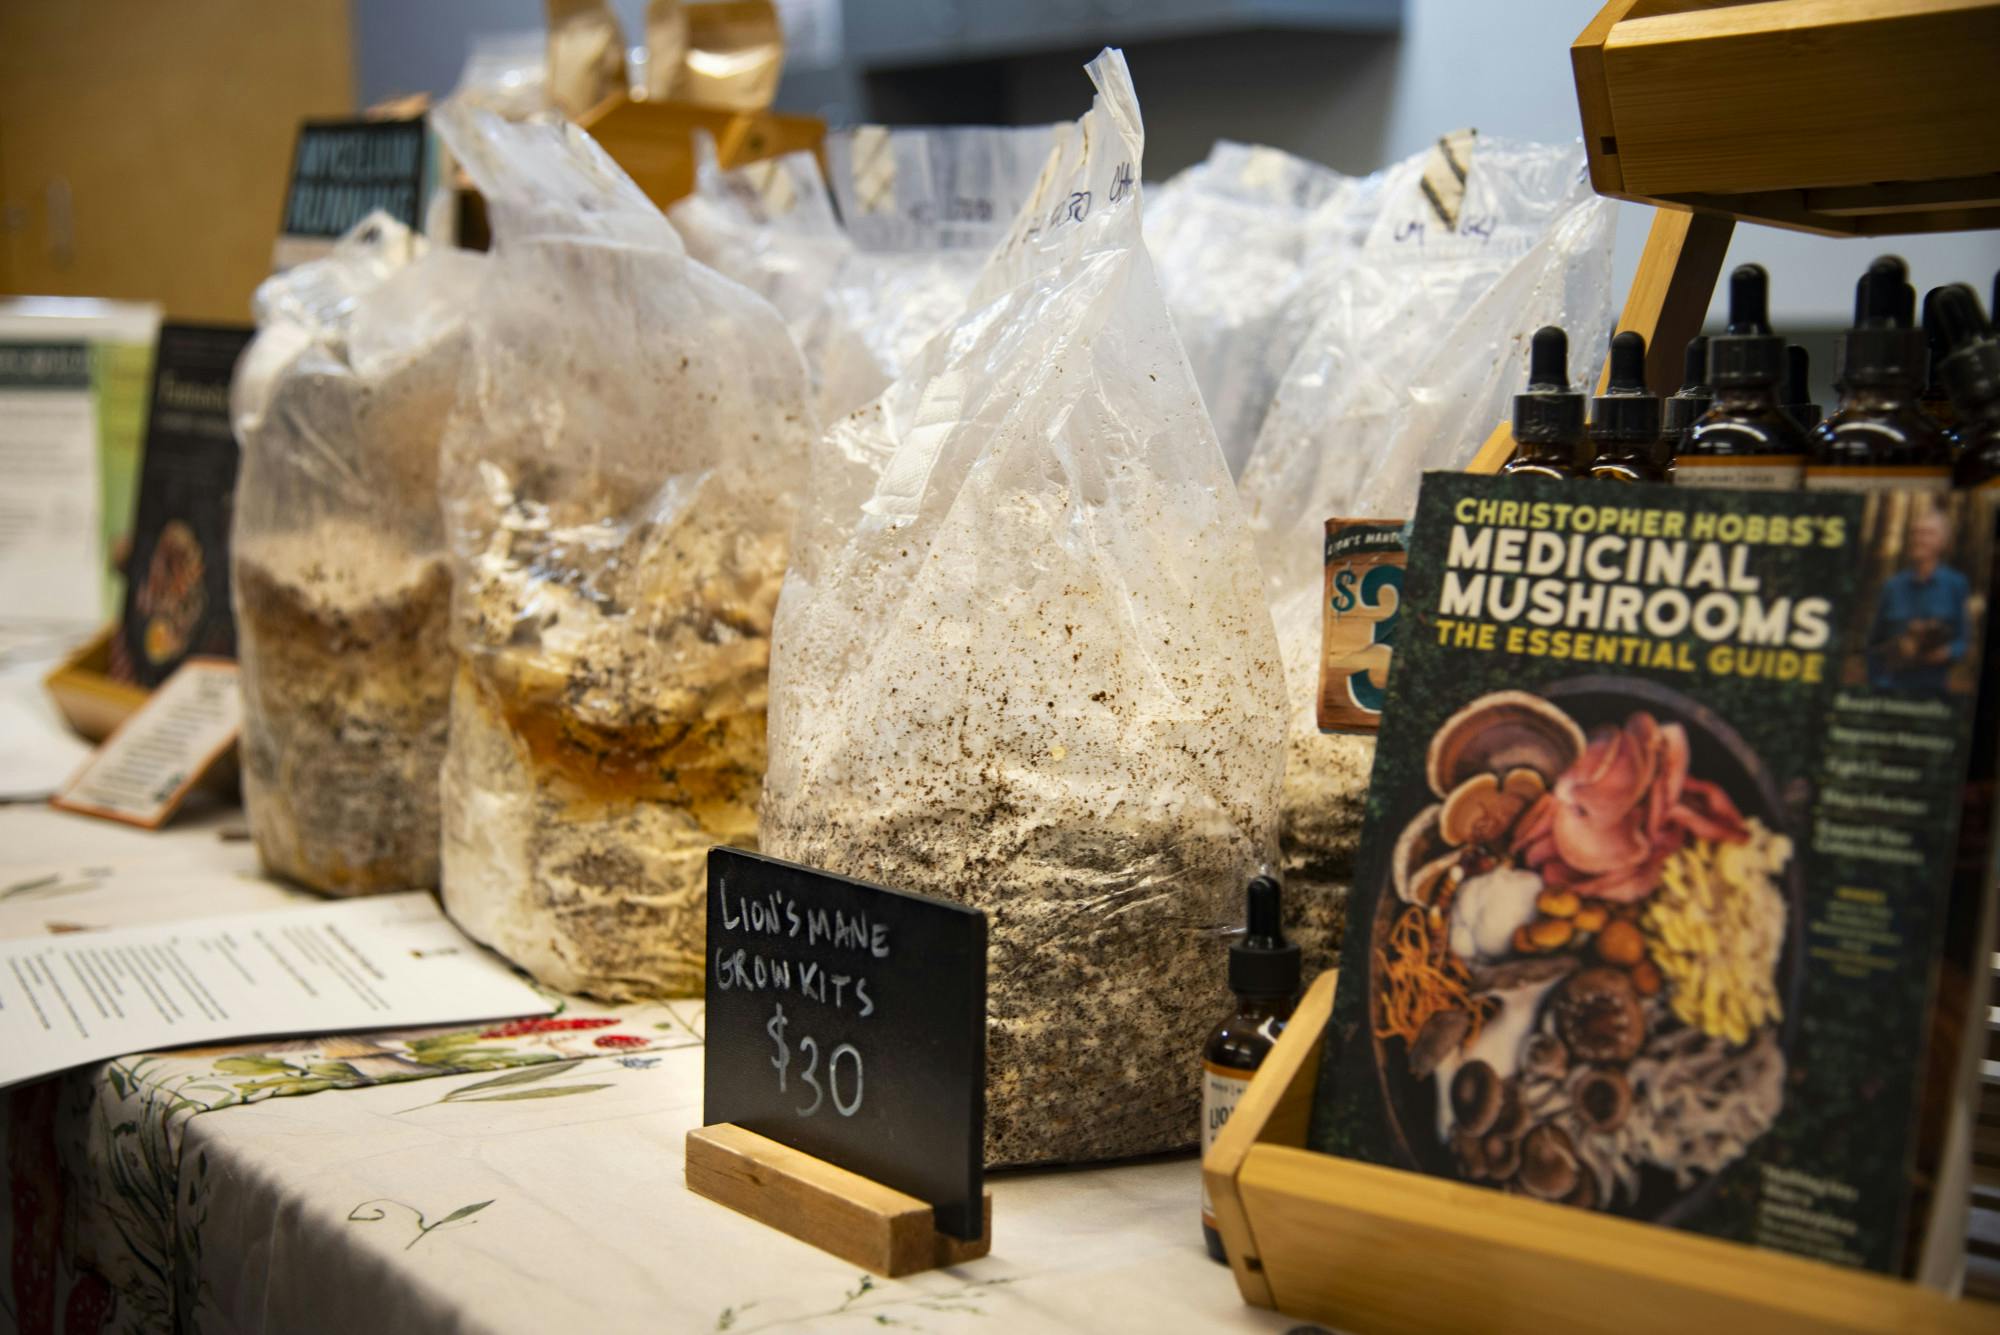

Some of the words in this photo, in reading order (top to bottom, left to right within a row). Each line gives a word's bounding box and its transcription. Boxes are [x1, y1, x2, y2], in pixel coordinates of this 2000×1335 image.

[1454, 497, 1686, 539] CHRISTOPHER
[1692, 512, 1846, 548] HOBBS'S
[1446, 525, 1760, 593] MEDICINAL
[1438, 571, 1832, 650] MUSHROOMS
[1435, 619, 1498, 652] THE
[1506, 627, 1696, 672] ESSENTIAL
[1706, 646, 1826, 684] GUIDE
[719, 878, 800, 938] LION'S
[807, 908, 890, 958] MANE
[716, 947, 791, 991] GROW
[799, 961, 875, 1017] KITS
[767, 1002, 864, 1117] $30
